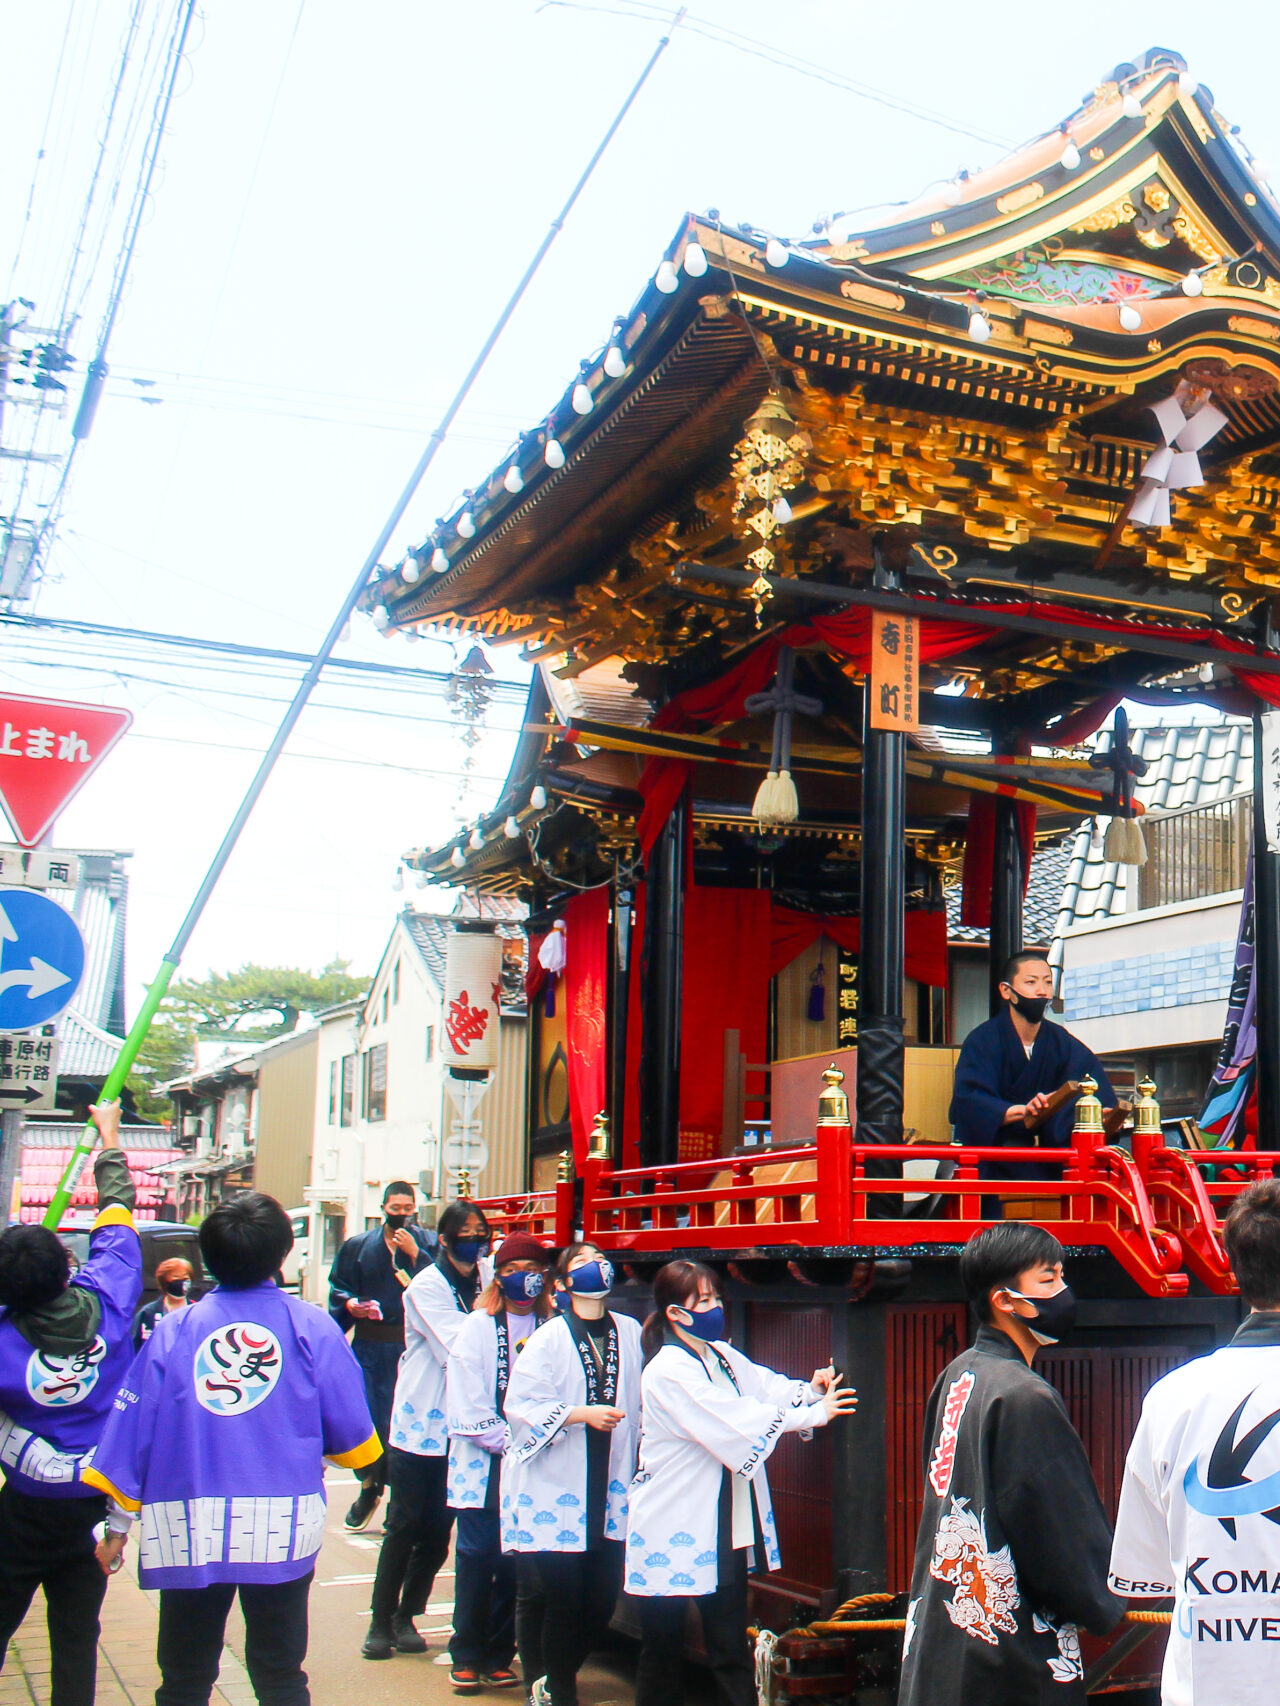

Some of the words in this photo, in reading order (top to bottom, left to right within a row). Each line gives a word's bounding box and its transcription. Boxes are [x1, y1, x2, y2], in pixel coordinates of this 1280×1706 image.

[0, 722, 92, 763] 止まれ
[578, 1340, 598, 1405] 公立小松大
